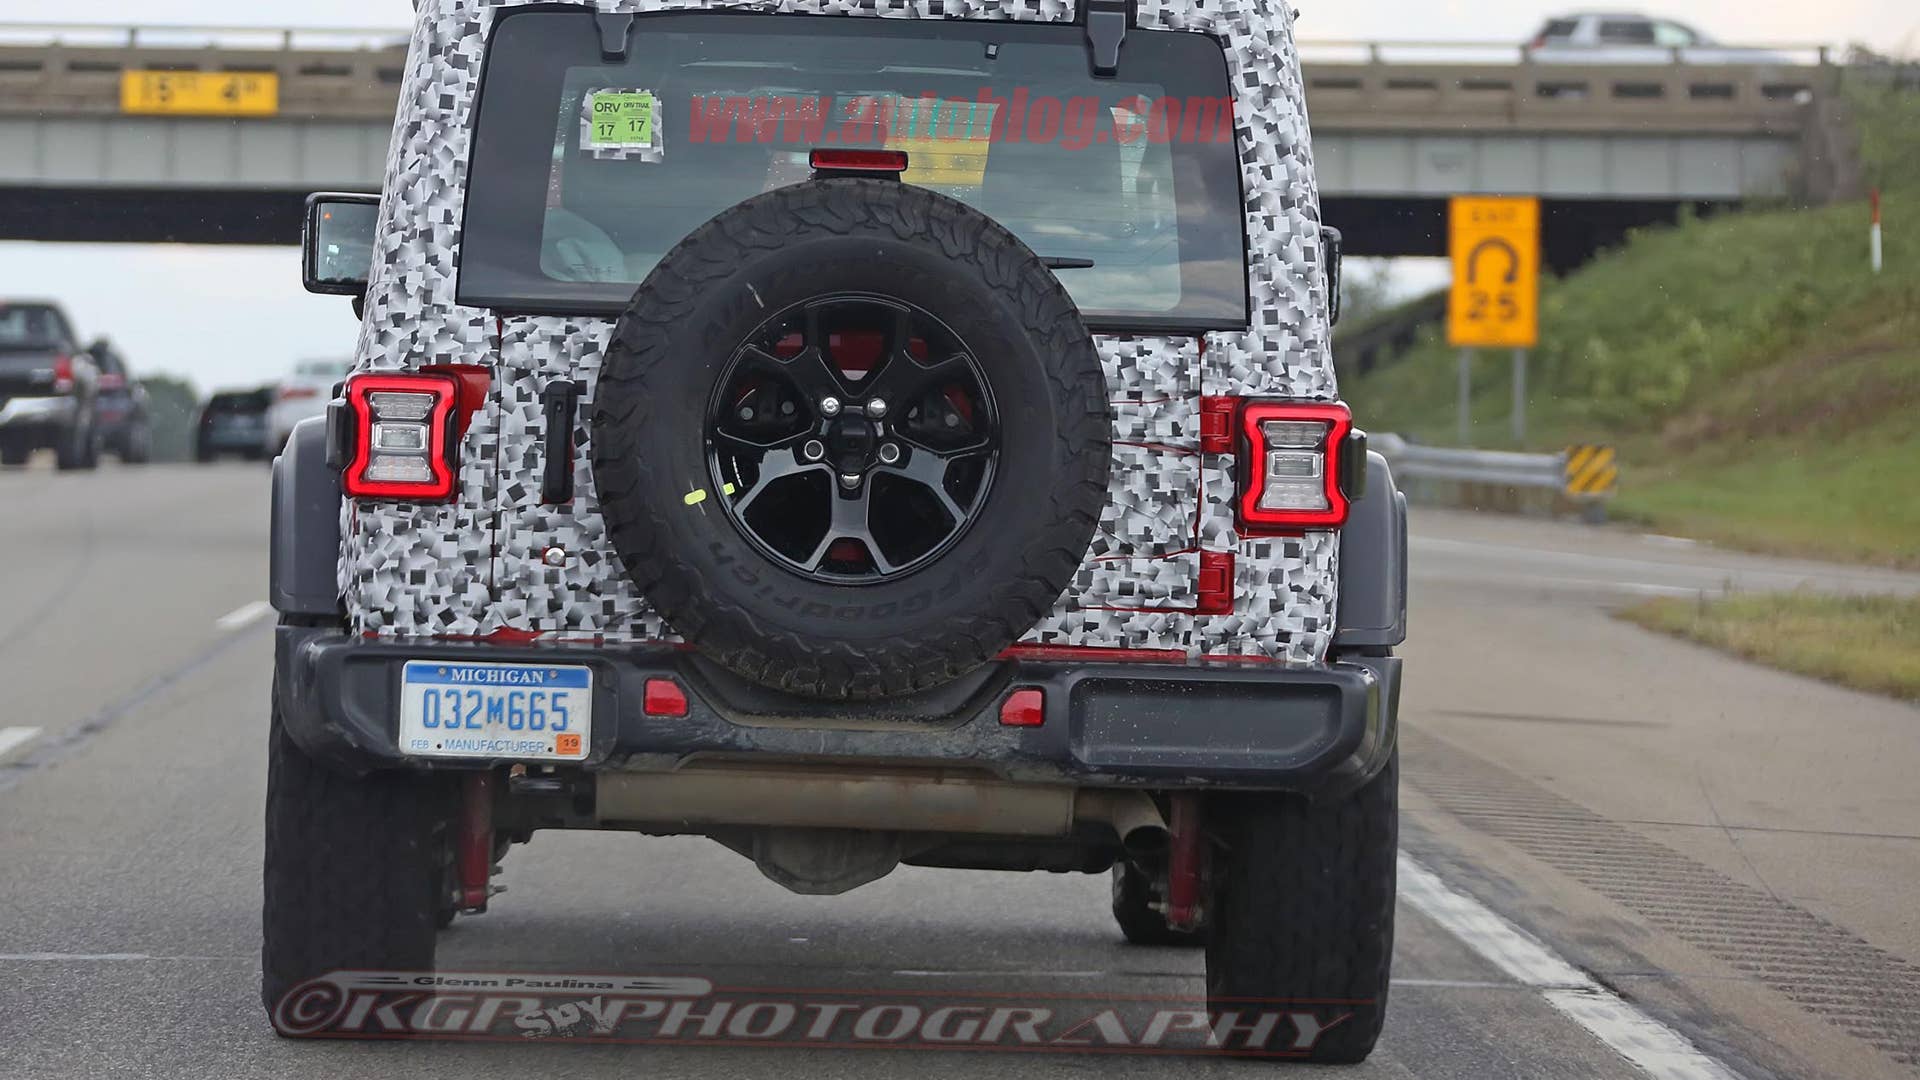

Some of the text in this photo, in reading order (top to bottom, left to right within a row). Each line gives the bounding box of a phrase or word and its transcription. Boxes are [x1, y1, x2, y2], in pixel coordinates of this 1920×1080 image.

[594, 102, 621, 113] ORV
[598, 124, 615, 136] 17
[628, 120, 645, 132] 17
[1466, 290, 1520, 322] 25
[451, 667, 544, 684] MICHIGAN
[422, 688, 569, 732] 032M665
[410, 738, 545, 753] FEB MANUFACTURER
[563, 738, 579, 748] 19
